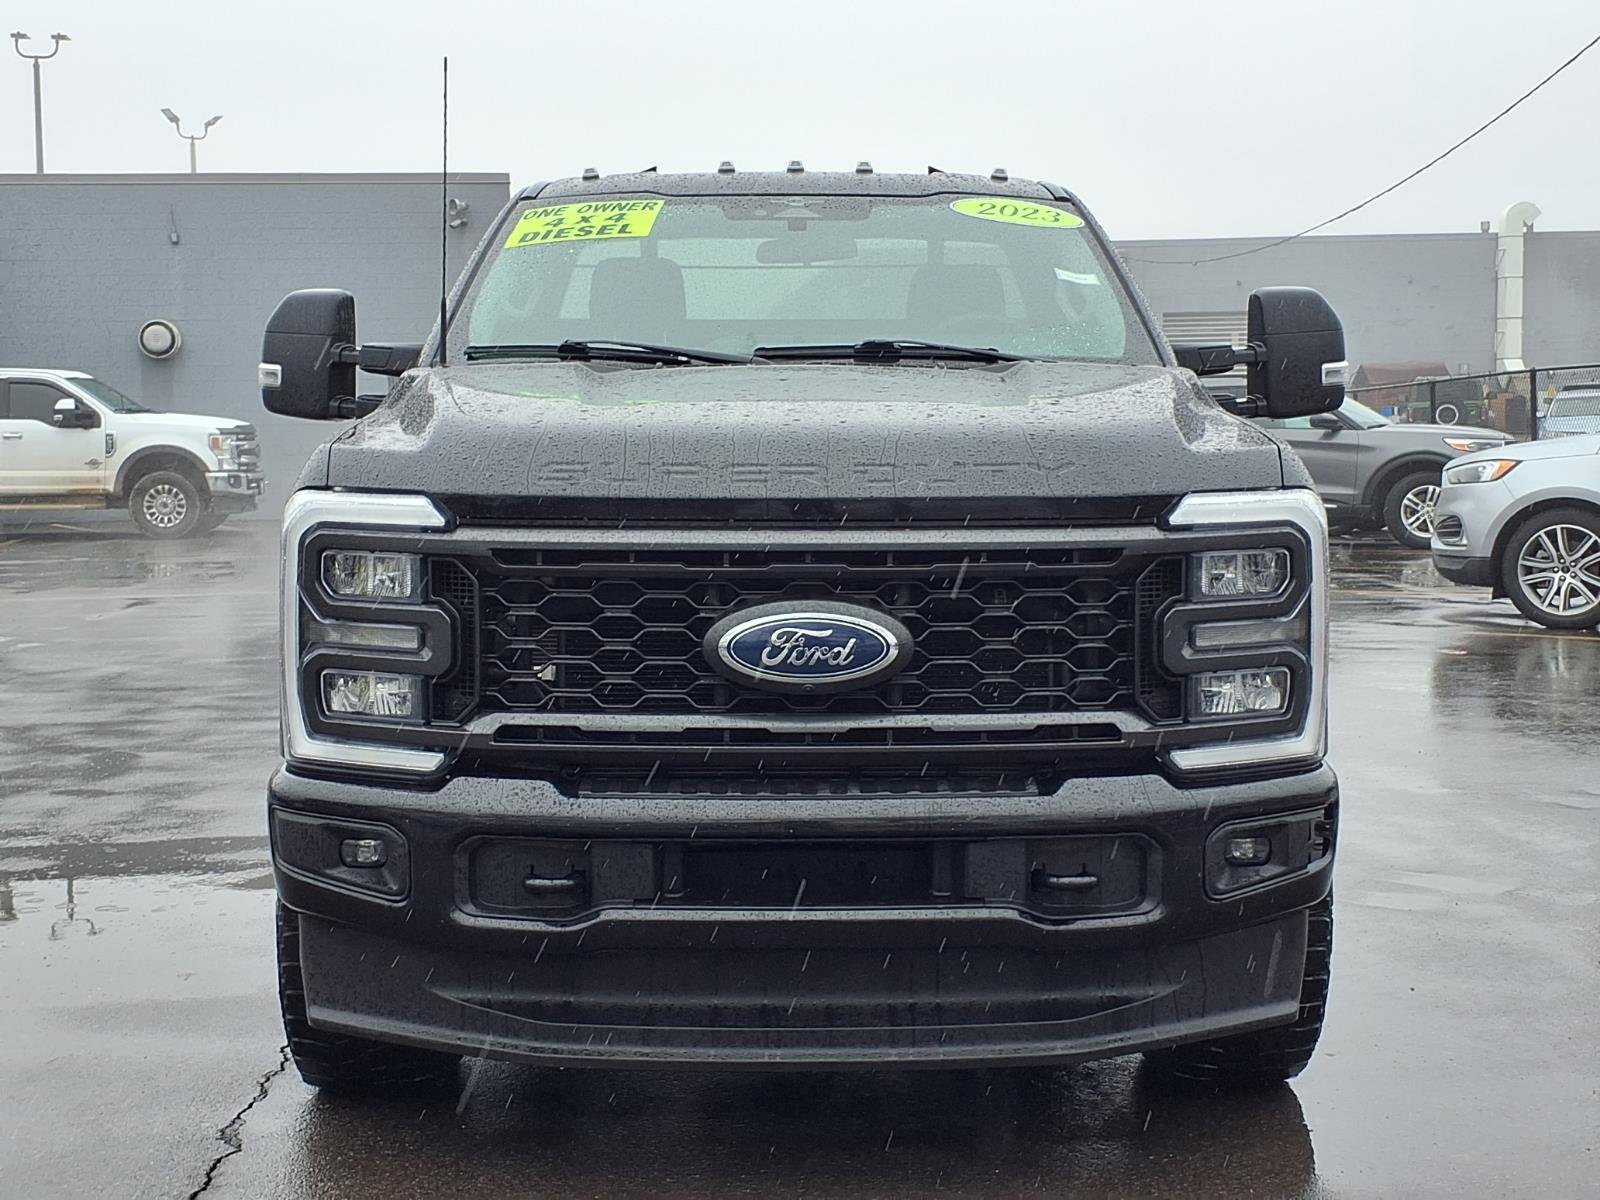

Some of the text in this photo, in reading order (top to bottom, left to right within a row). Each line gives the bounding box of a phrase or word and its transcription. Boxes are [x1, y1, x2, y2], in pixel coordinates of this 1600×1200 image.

[523, 202, 659, 220] ONE OWNER
[977, 202, 1061, 223] 2023
[518, 223, 633, 243] DIESEL
[534, 460, 1077, 486] SUPER DUTY
[761, 627, 857, 666] Ford
